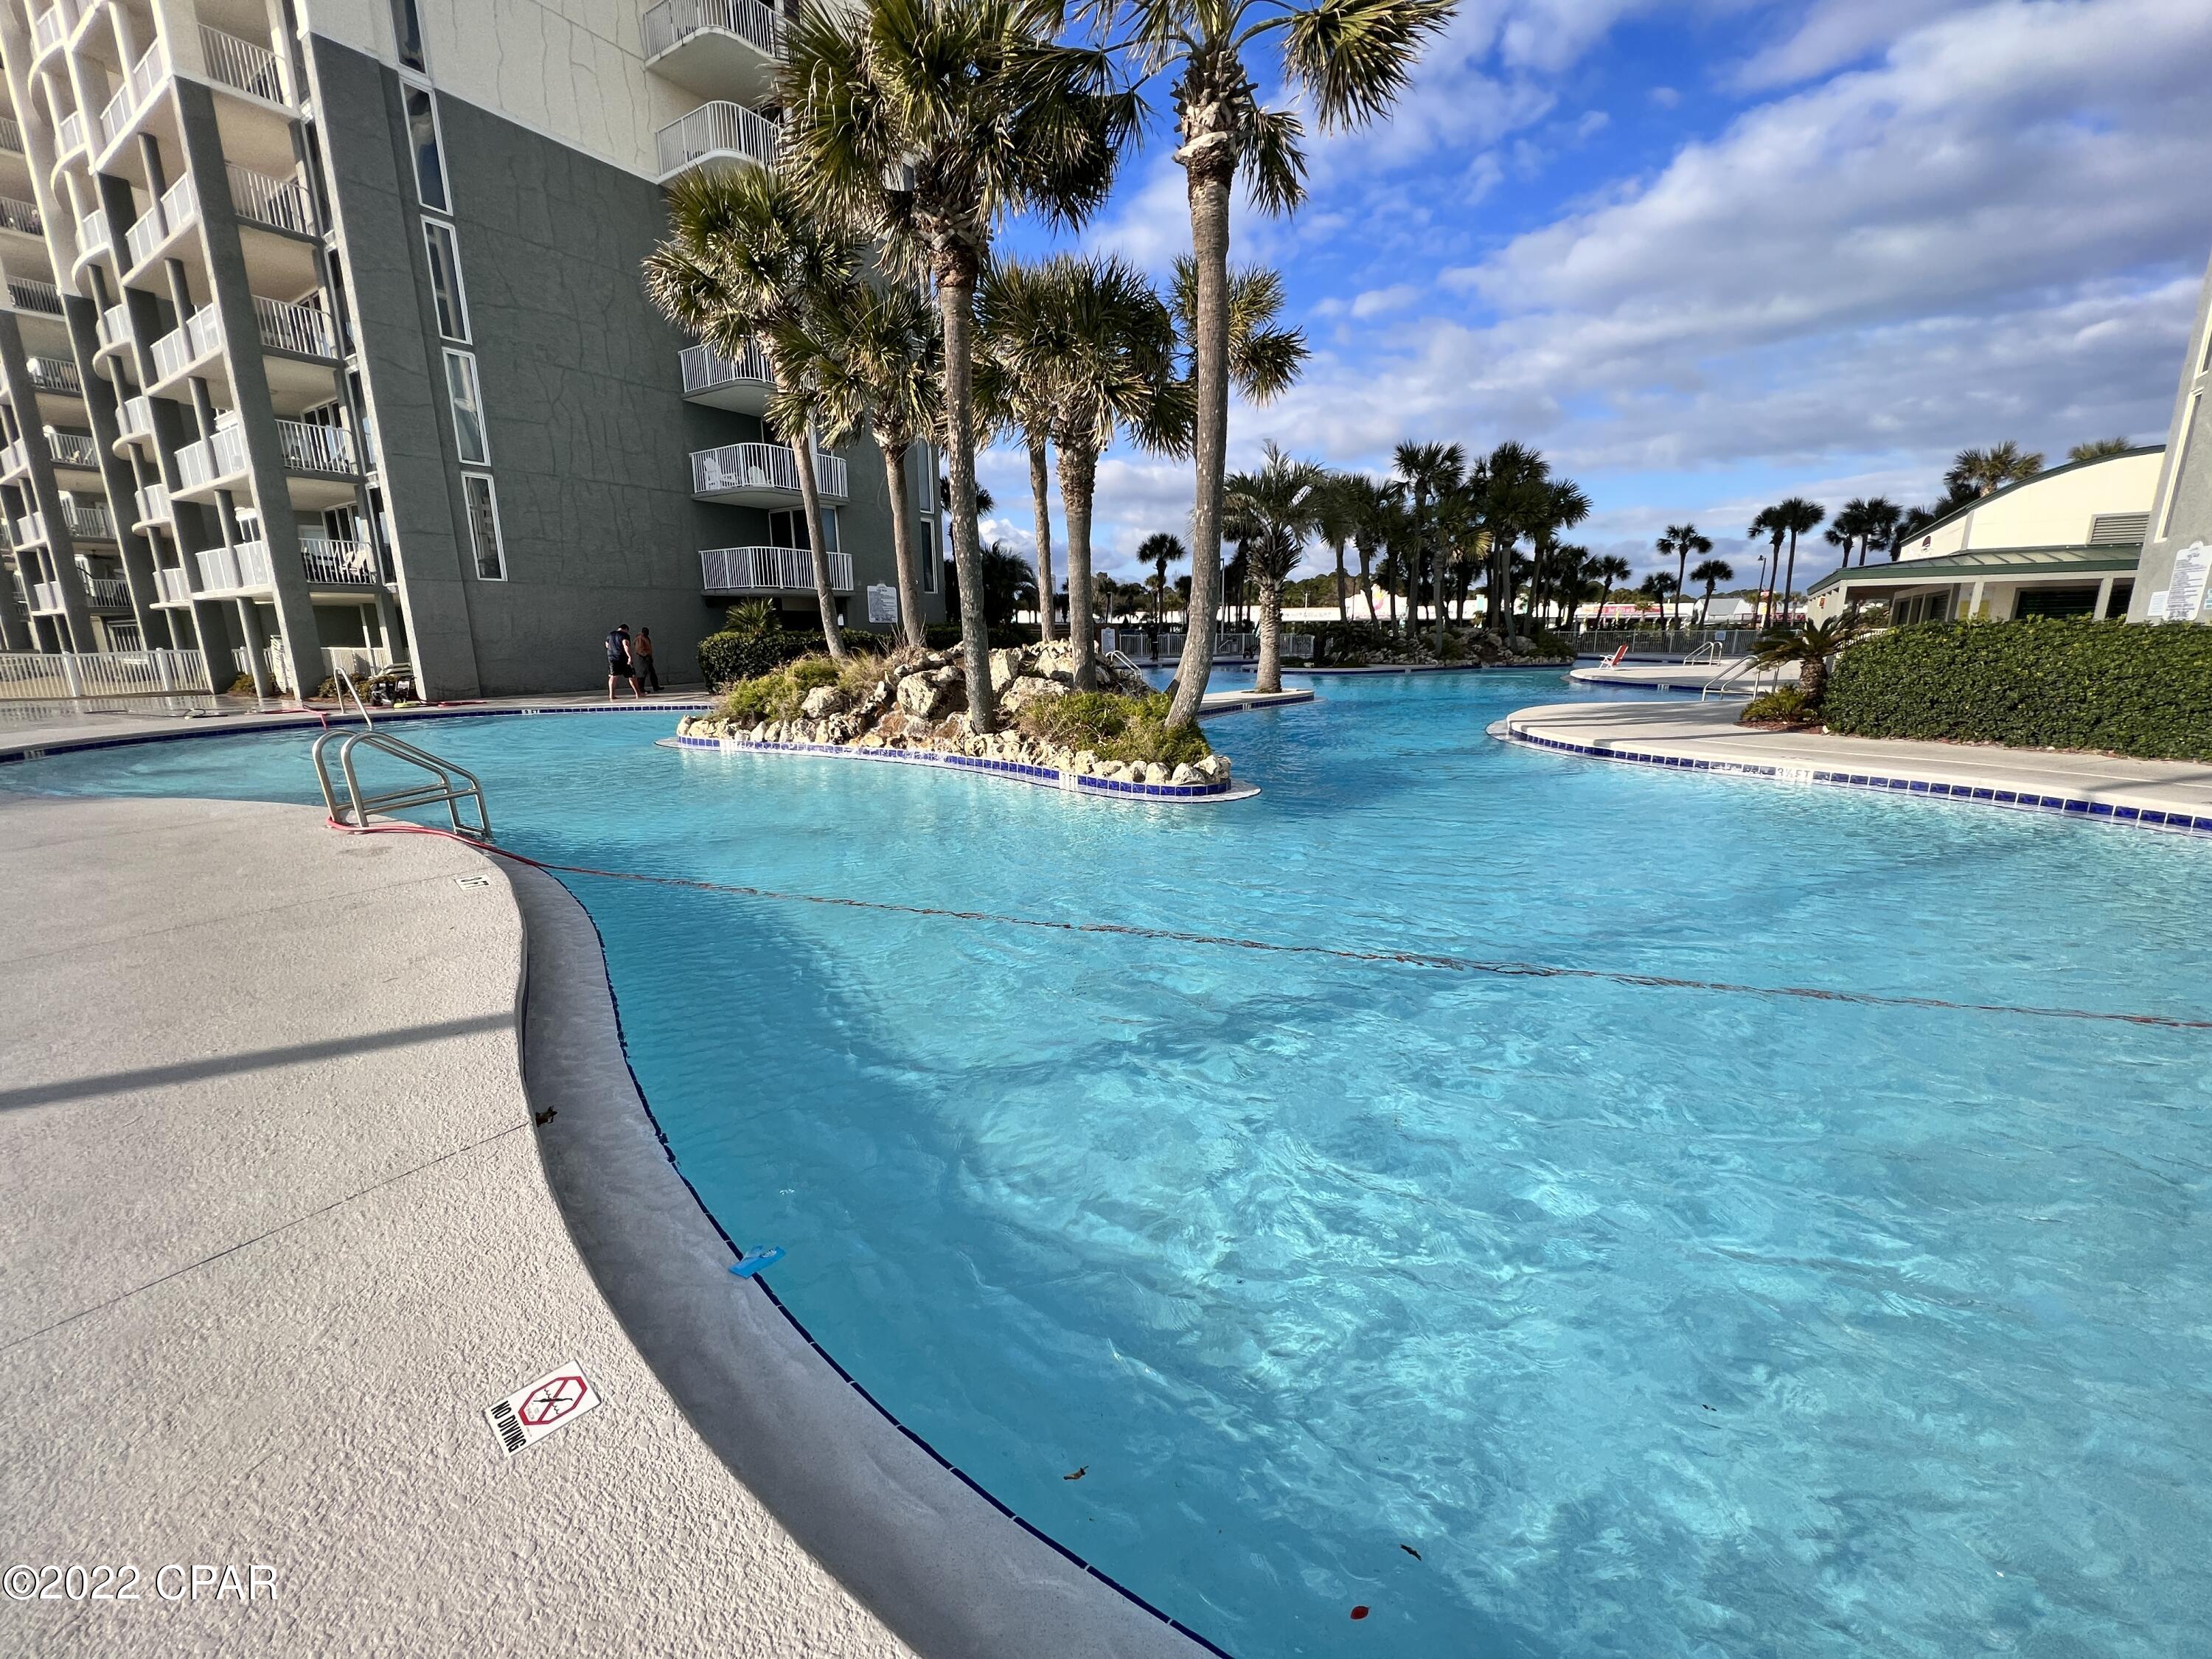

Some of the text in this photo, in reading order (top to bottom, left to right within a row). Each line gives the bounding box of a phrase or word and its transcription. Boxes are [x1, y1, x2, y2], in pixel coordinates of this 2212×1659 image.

[1795, 769, 1811, 778] FT
[490, 1400, 526, 1453] NO DIVING
